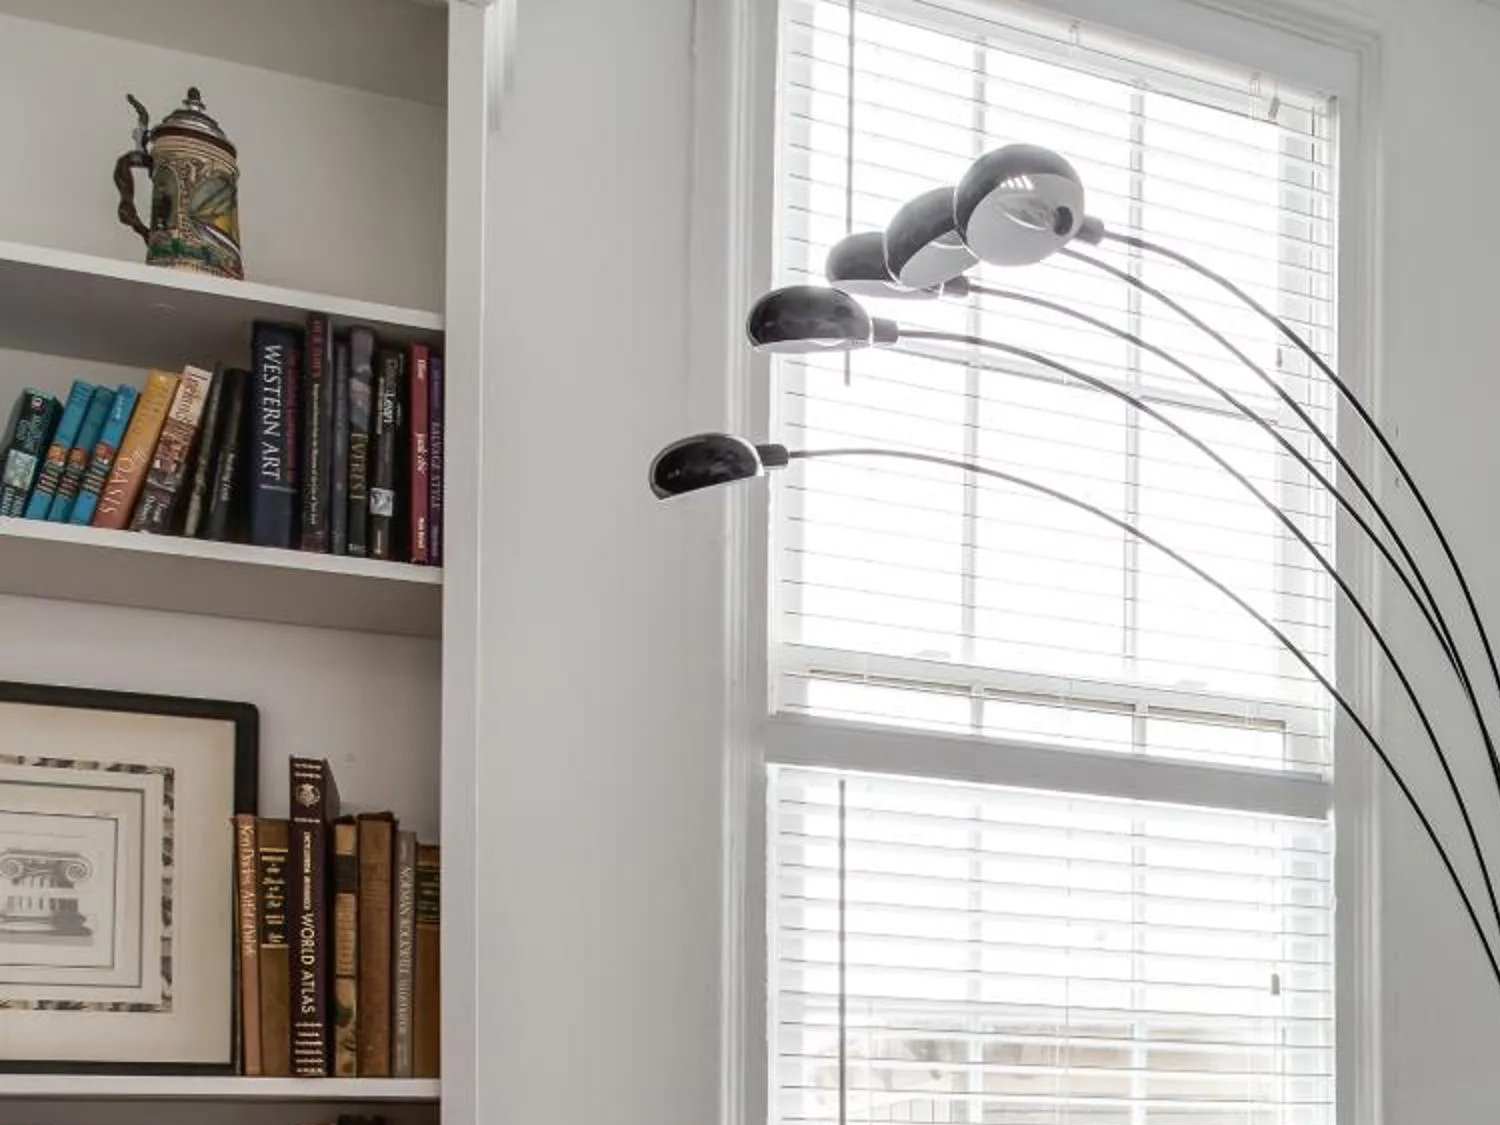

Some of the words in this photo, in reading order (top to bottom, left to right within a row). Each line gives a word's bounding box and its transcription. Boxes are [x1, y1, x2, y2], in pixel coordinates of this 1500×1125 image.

[262, 344, 283, 436] WESTERN
[99, 455, 132, 514] OASIS
[262, 441, 282, 481] ART
[351, 432, 369, 500] EVEREST
[301, 914, 316, 965] WORLD
[301, 971, 316, 1014] ATLAS
